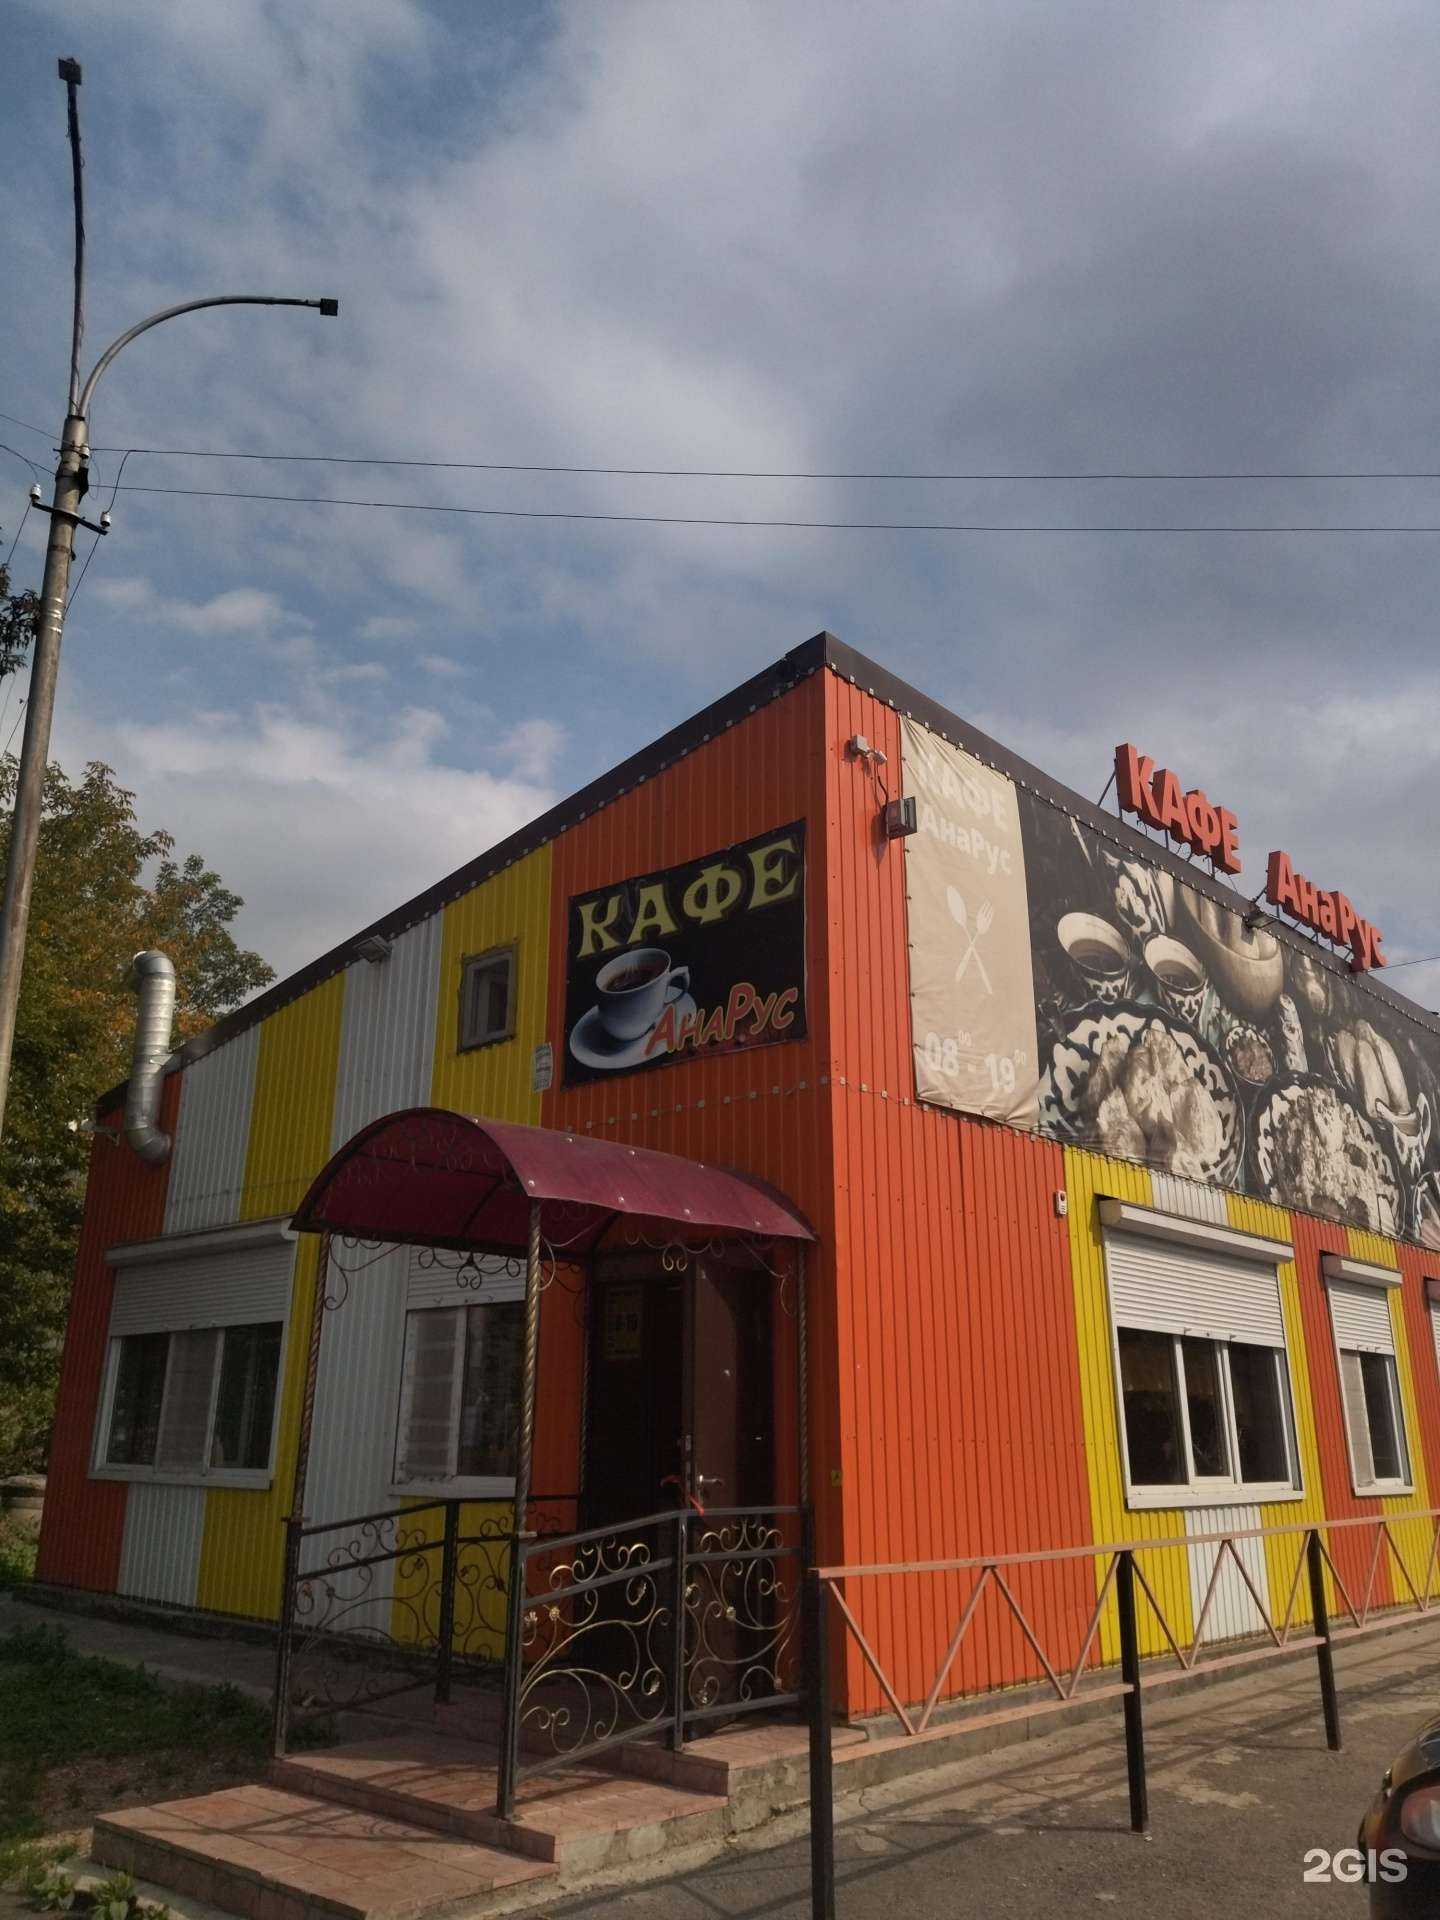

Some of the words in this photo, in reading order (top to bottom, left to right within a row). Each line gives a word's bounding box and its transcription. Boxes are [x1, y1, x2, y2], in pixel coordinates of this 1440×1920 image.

[577, 838, 799, 958] КАФЕ
[1116, 743, 1242, 874] КАФЕ
[1266, 851, 1388, 972] АнаРус
[644, 983, 799, 1056] АнаРус
